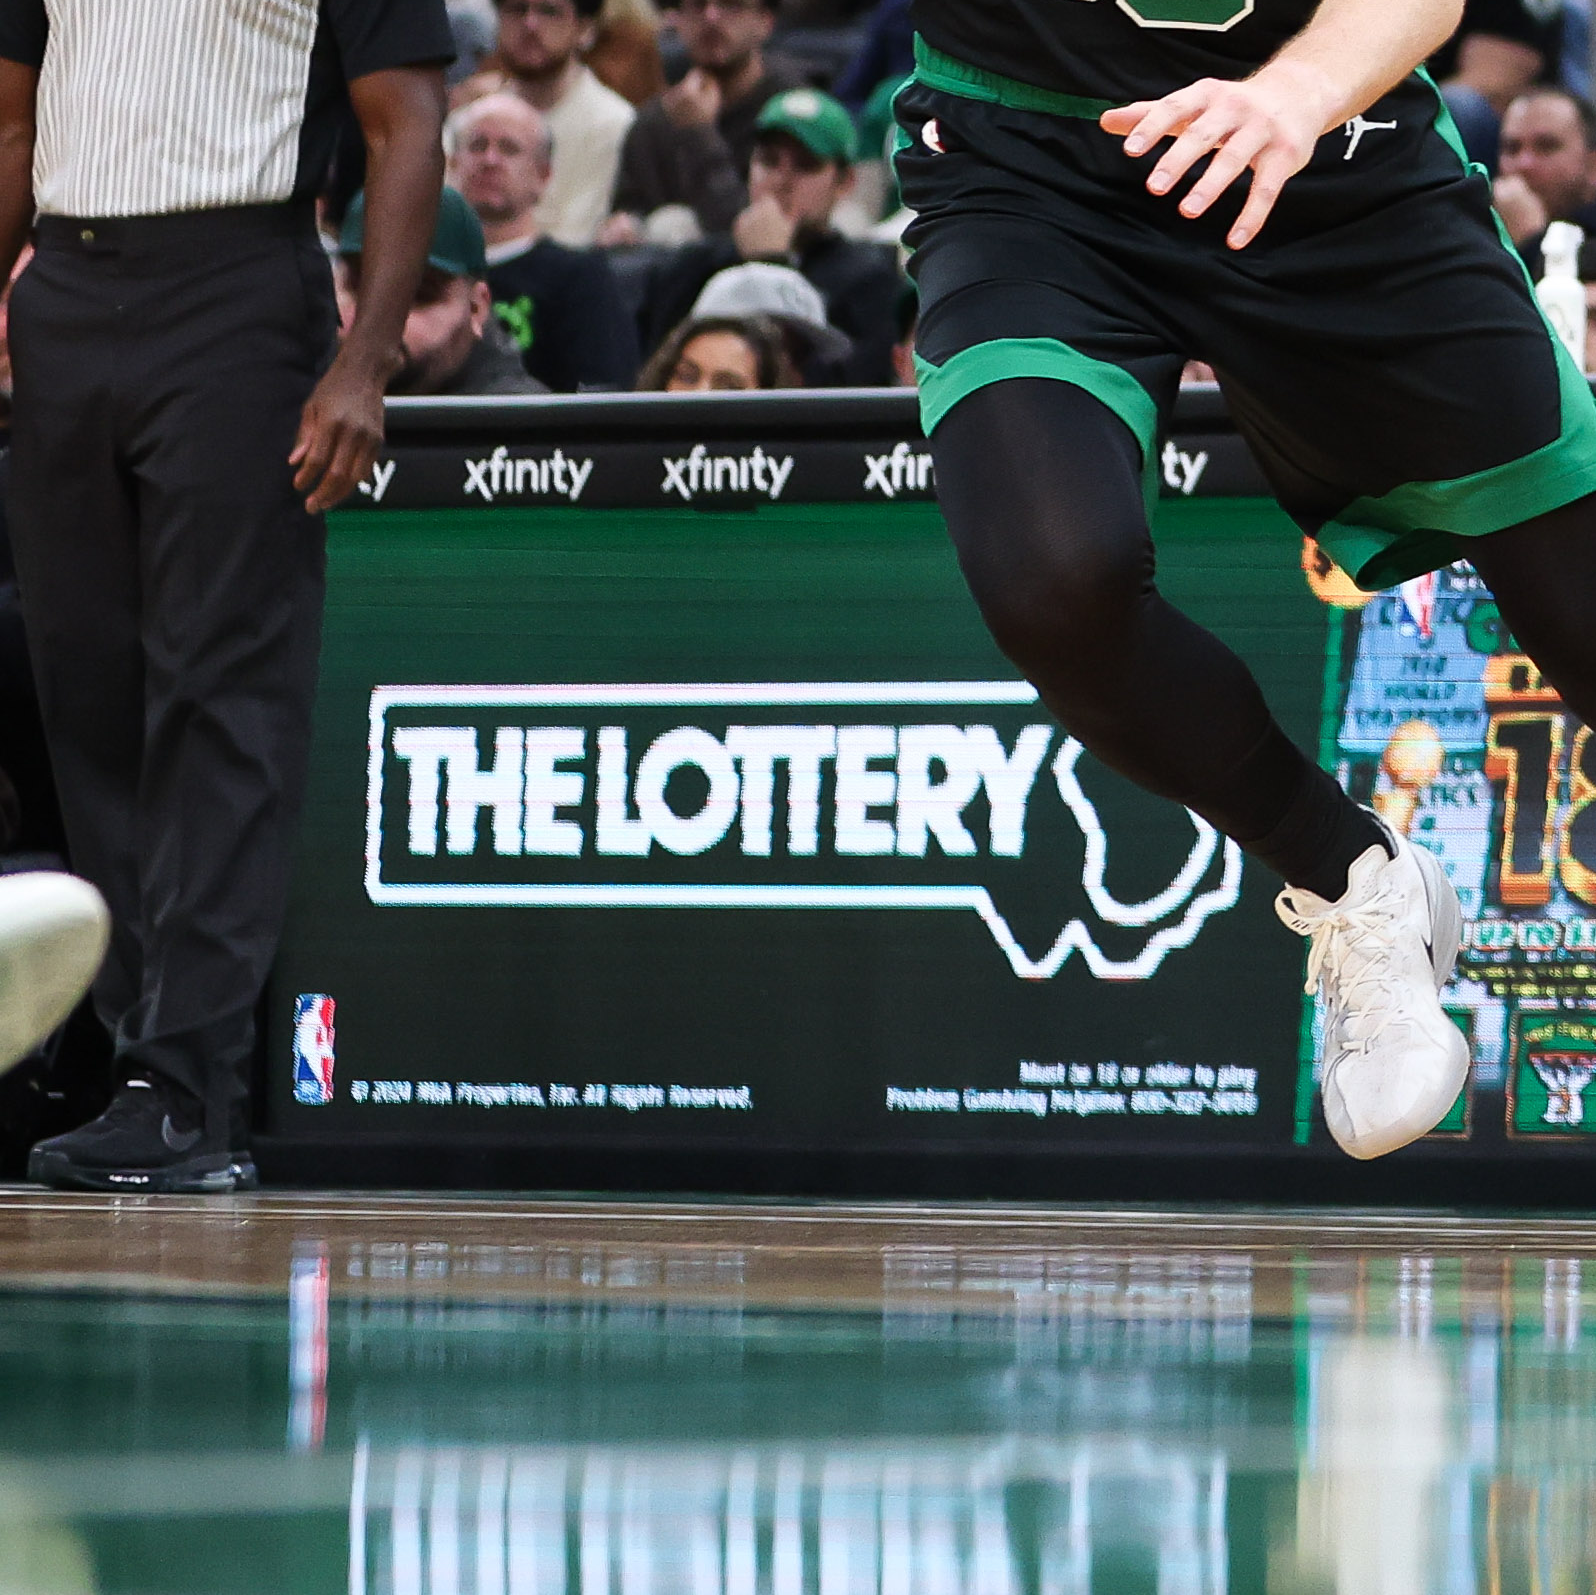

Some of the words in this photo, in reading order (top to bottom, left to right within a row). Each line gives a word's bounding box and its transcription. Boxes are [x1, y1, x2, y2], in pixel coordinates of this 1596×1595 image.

[464, 445, 594, 502] xfinity
[661, 443, 795, 501] xfinity
[862, 441, 937, 498] xfin
[392, 727, 586, 857] THE
[597, 722, 1054, 857] LOTTERY
